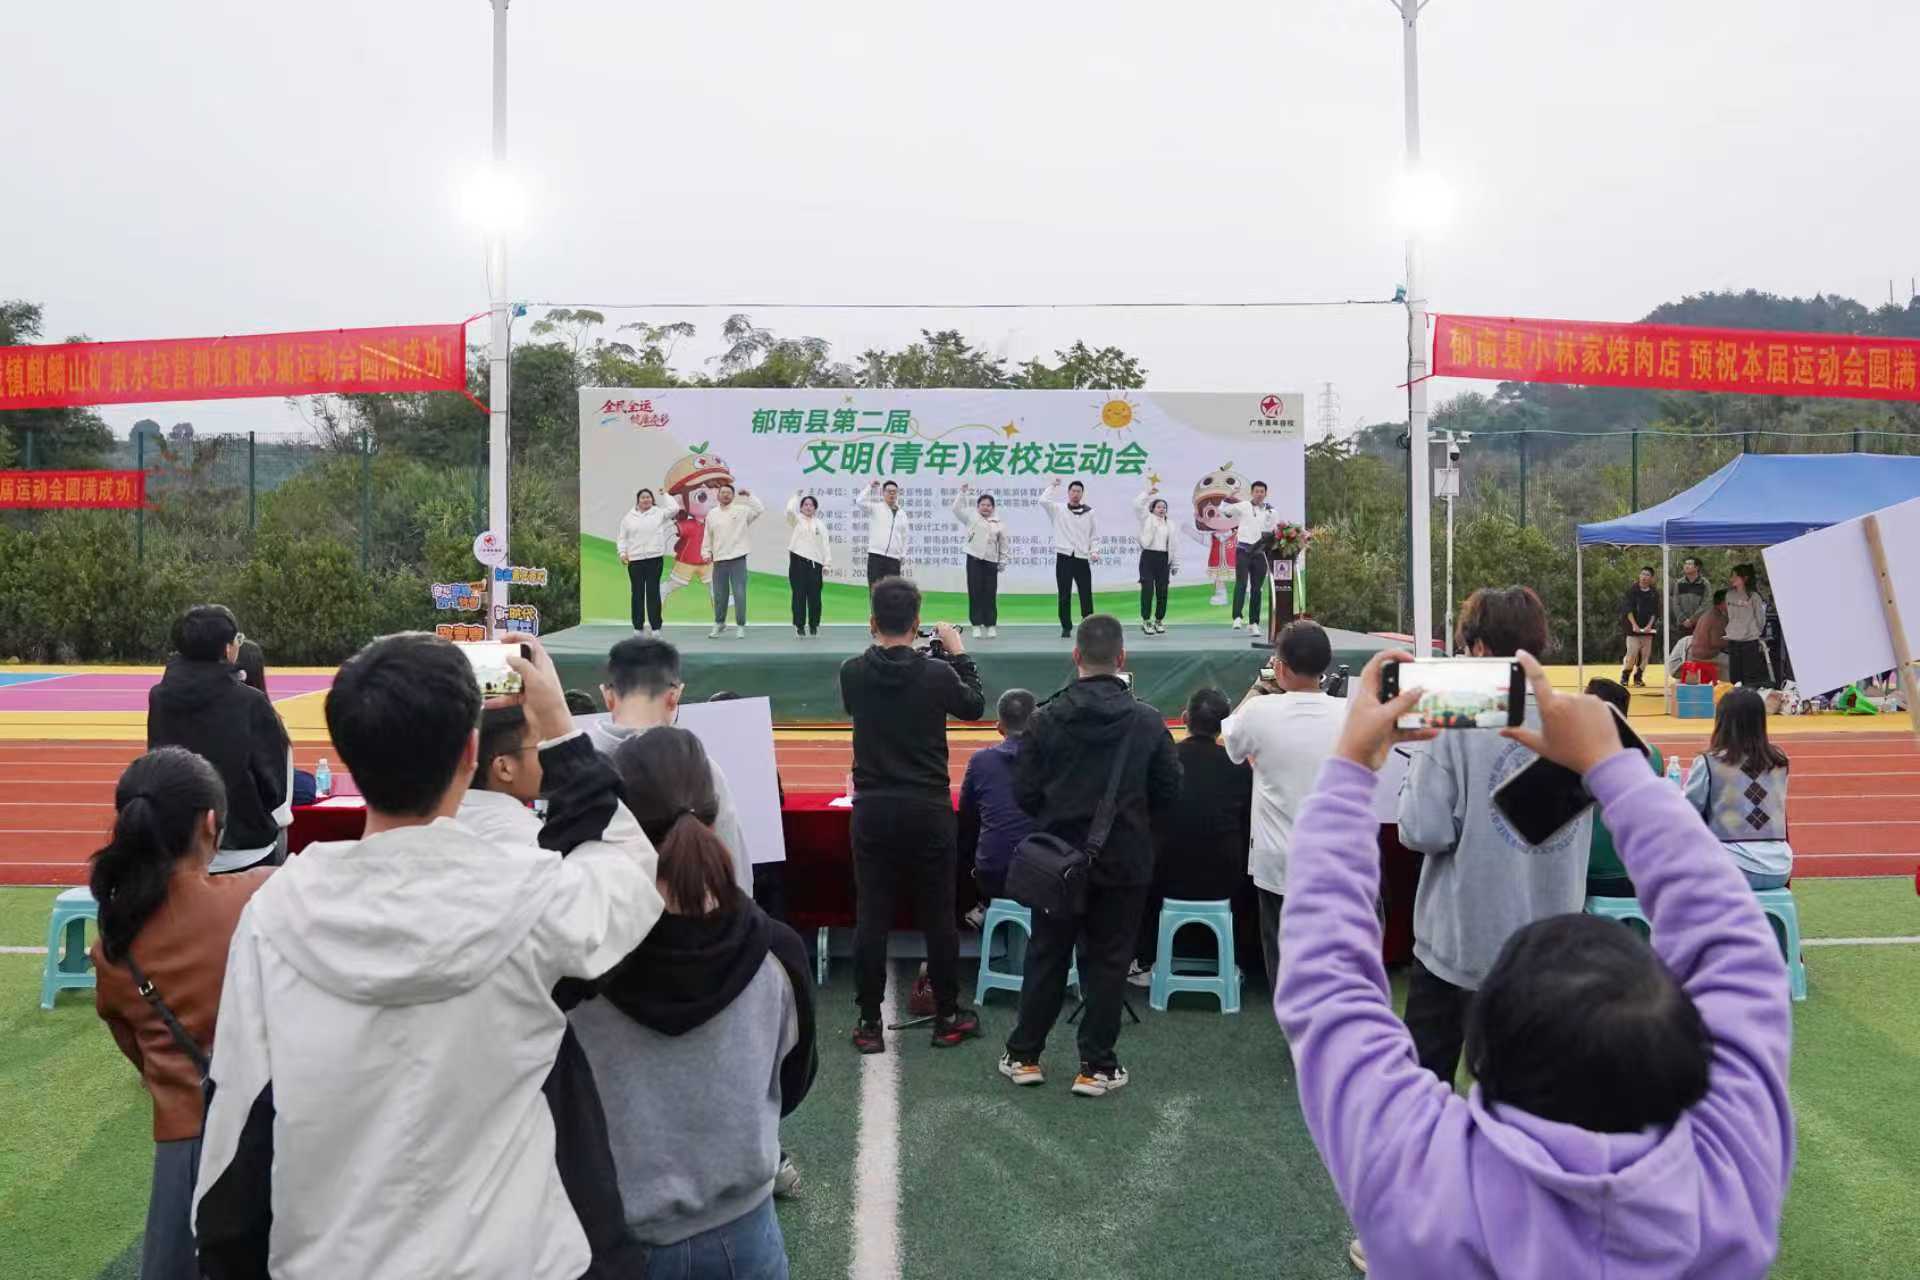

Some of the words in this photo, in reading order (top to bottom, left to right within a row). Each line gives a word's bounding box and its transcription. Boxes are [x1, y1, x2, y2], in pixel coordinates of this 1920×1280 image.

[1450, 326, 1681, 378] 郁南县小林家烤肉店
[752, 408, 911, 434] 郁南县第二届
[803, 440, 1150, 476] 文明(青年)夜校运动会
